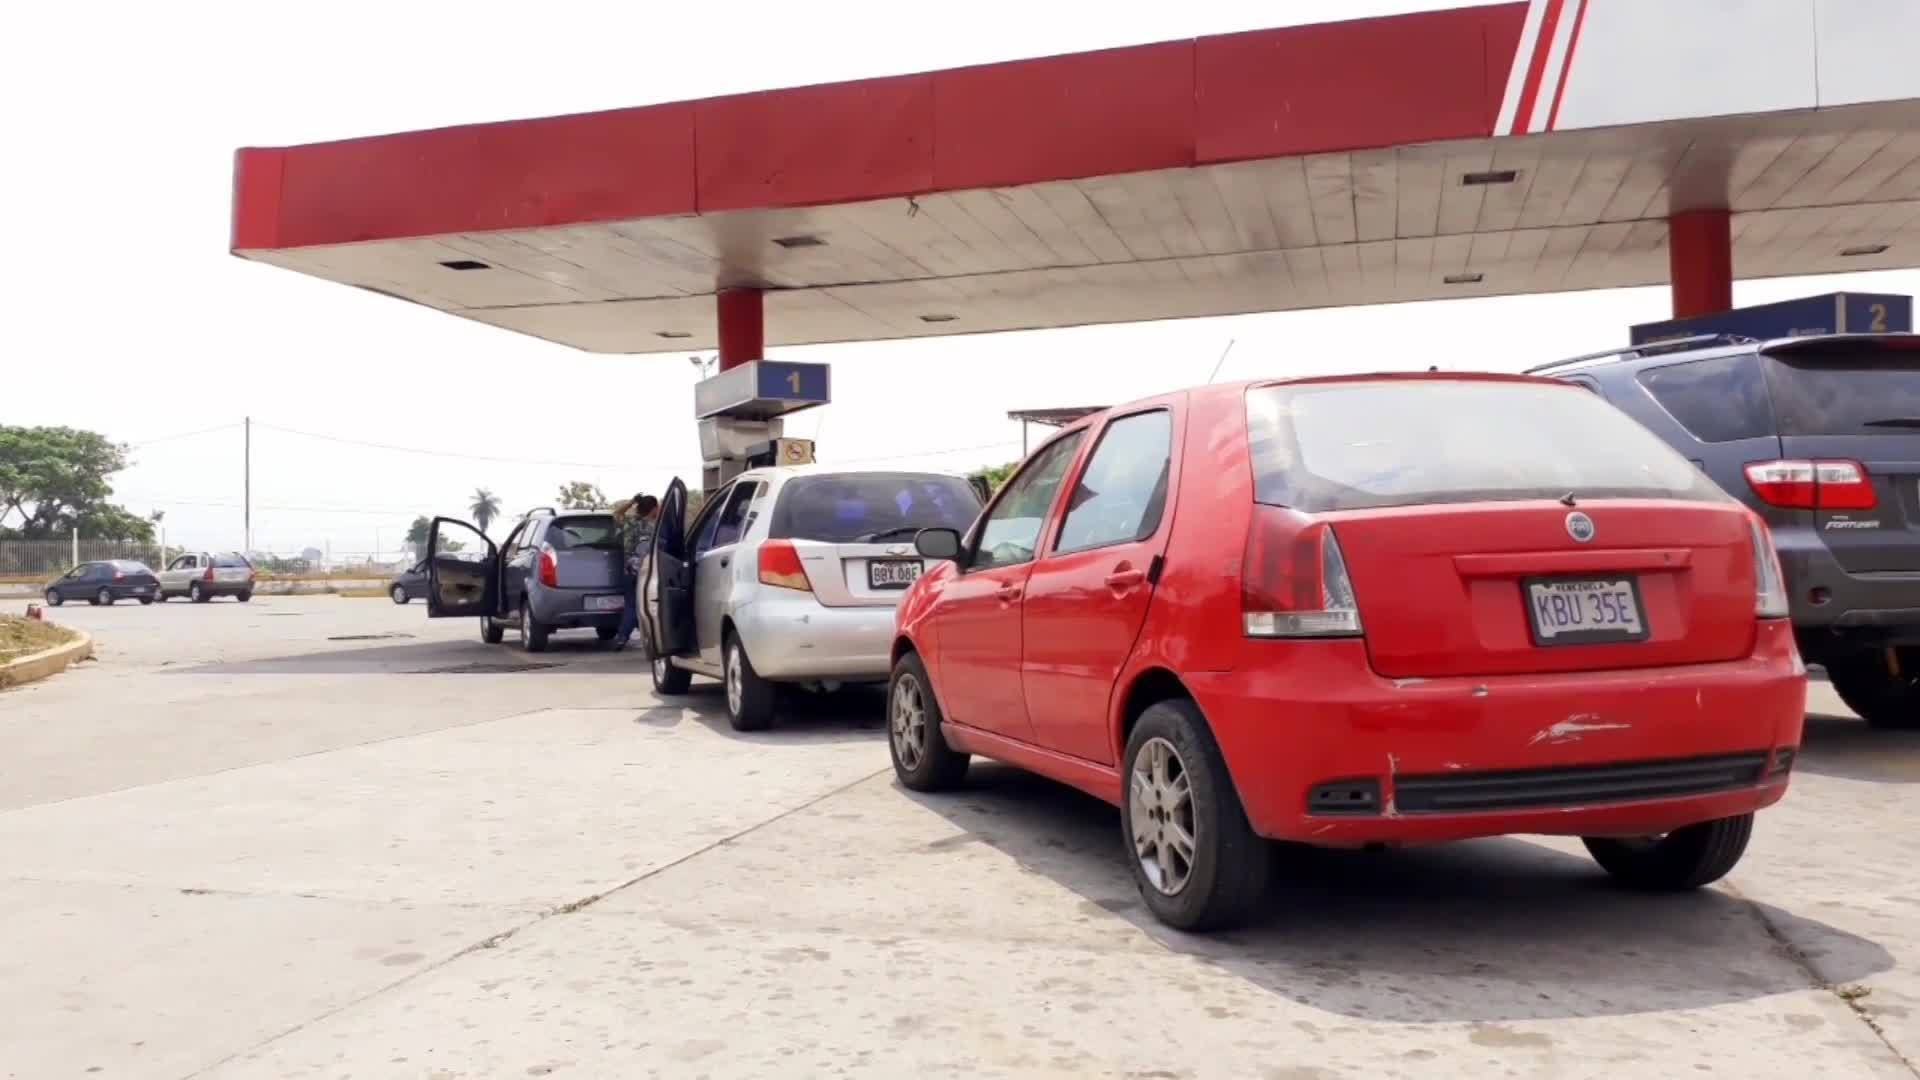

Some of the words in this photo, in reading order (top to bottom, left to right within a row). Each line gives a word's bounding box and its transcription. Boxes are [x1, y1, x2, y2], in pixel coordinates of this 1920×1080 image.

[1869, 303, 1887, 334] 2
[786, 371, 800, 395] 1
[1537, 594, 1583, 626] KBU
[1588, 591, 1634, 623] 35E
